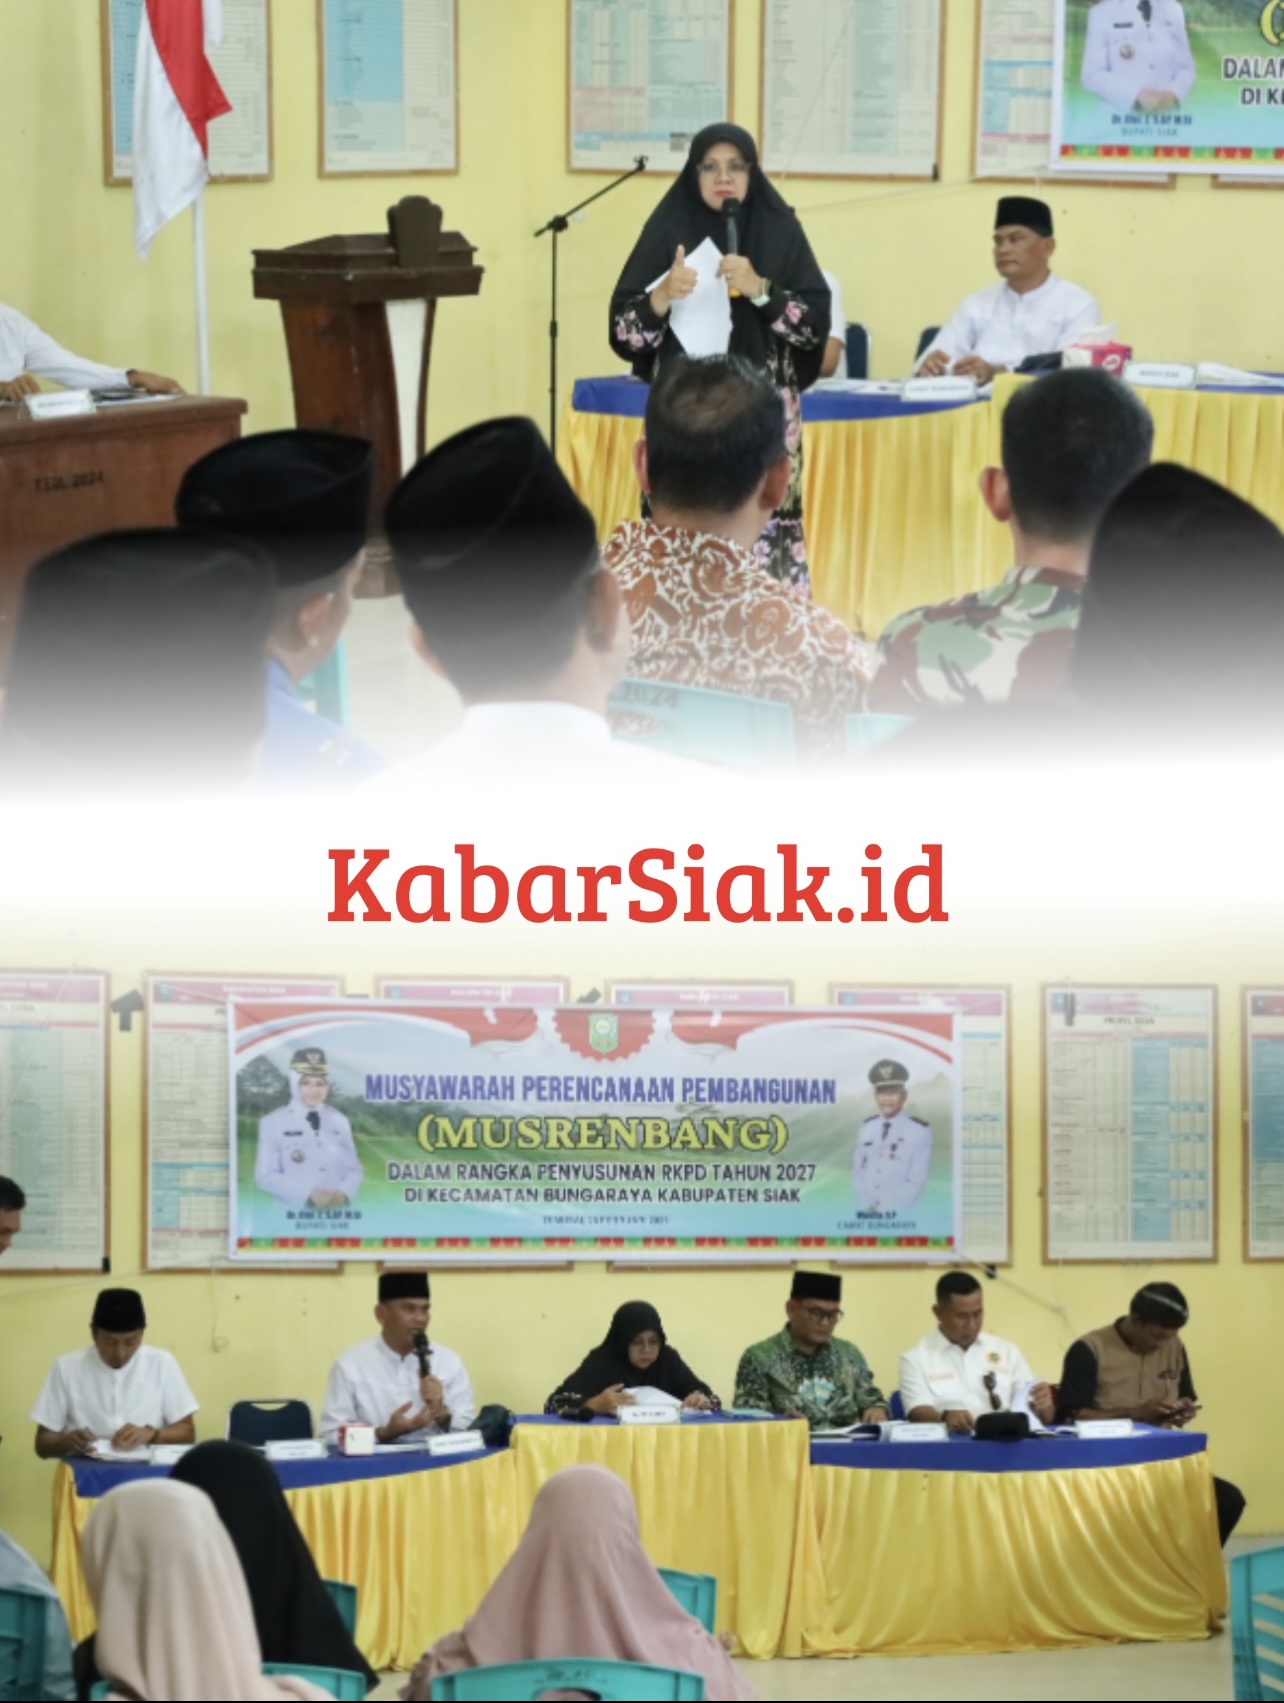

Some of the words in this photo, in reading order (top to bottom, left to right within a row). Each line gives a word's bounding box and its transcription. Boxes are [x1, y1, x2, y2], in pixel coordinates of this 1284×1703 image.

[1223, 57, 1284, 79] DALA
[1241, 88, 1261, 105] DI
[1267, 88, 1284, 105] K
[365, 1074, 514, 1101] MUSYAWARAH
[522, 1076, 674, 1103] PERENCANAAN
[682, 1077, 836, 1104] PEMBANGUNAN
[417, 1114, 788, 1154] (MUSRENBANG)
[388, 1162, 450, 1181] DALAM
[457, 1163, 532, 1181] RANGKA
[537, 1163, 655, 1181] PENYUSUNAN
[662, 1164, 707, 1181] RKPD
[712, 1164, 771, 1181] TAHUN
[776, 1164, 816, 1181] 2027
[405, 1188, 422, 1203] DI
[427, 1188, 539, 1203] KECAMATAN
[543, 1188, 652, 1203] BUNGARAYA
[658, 1188, 759, 1203] KABUPATEN
[763, 1188, 801, 1203] SIAK
